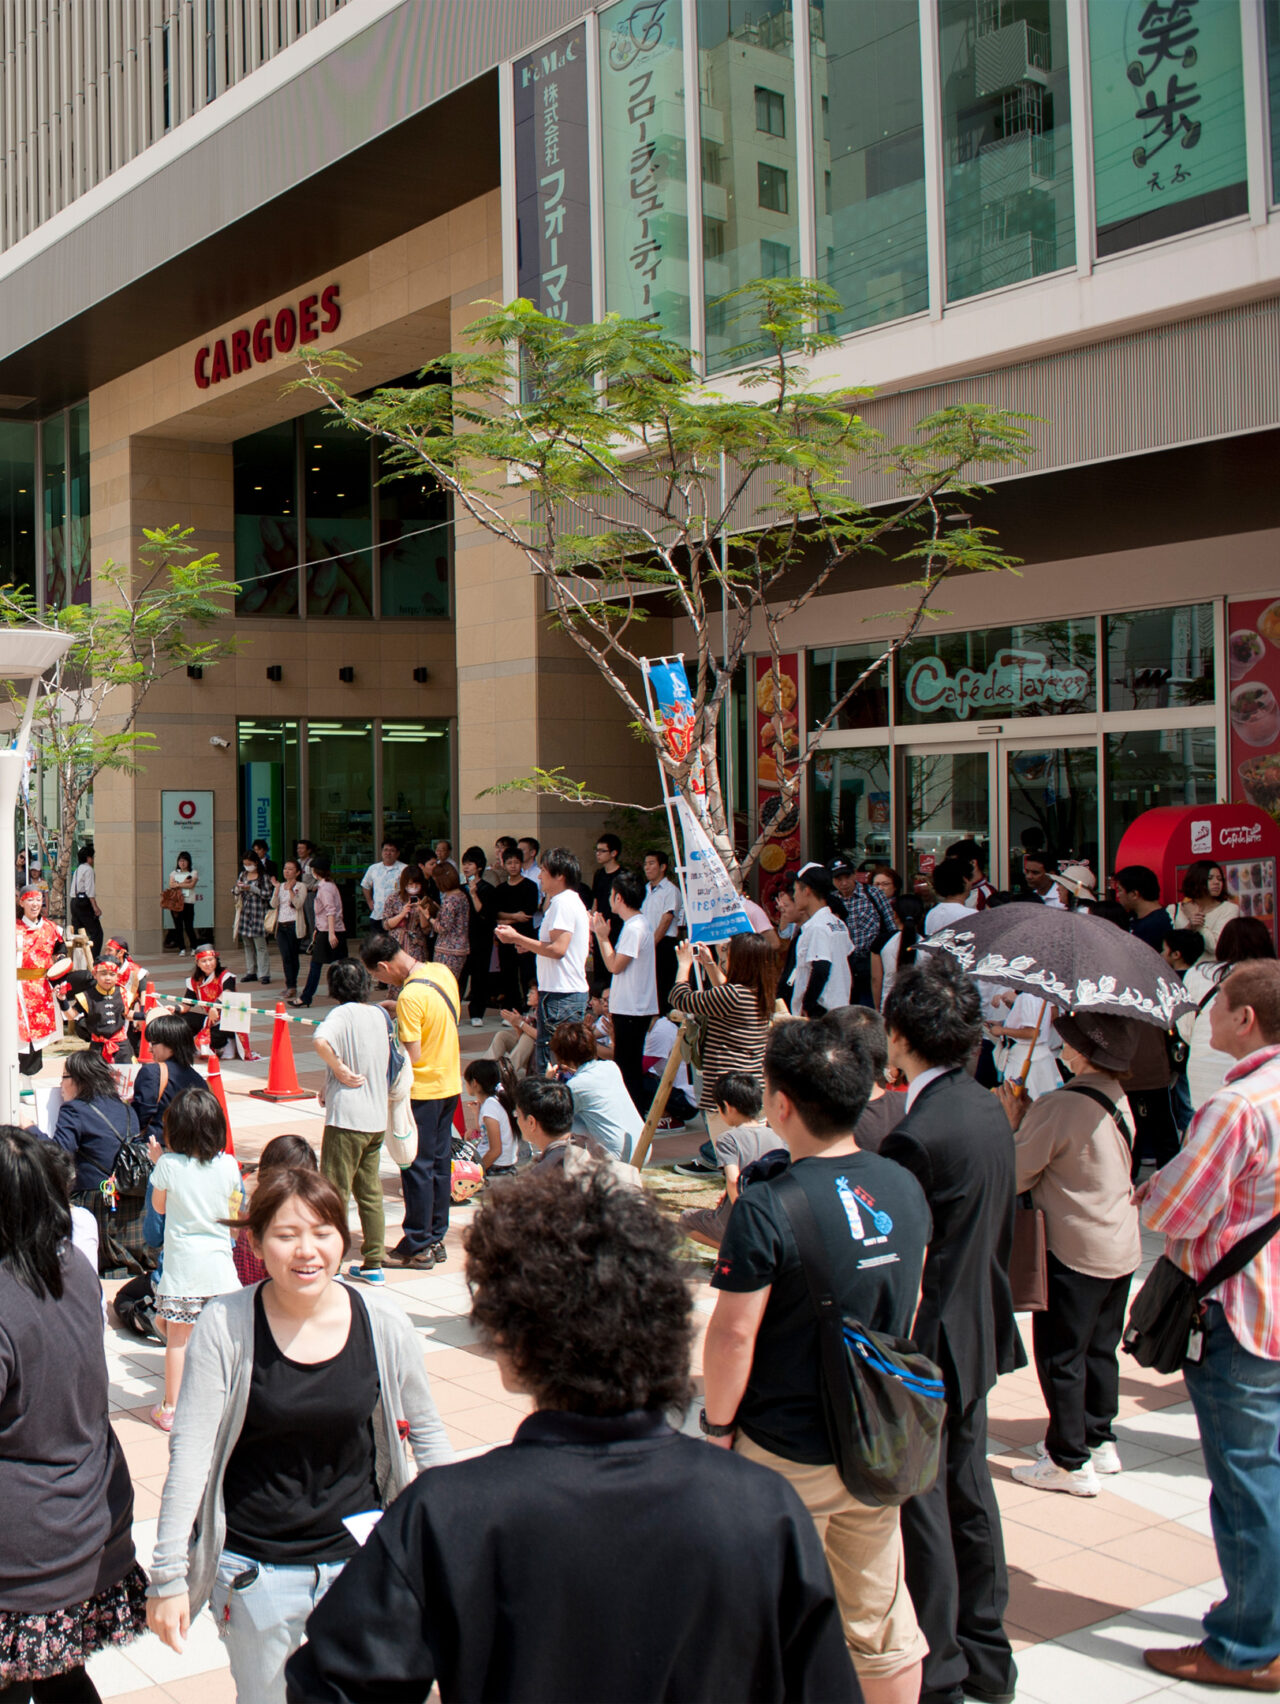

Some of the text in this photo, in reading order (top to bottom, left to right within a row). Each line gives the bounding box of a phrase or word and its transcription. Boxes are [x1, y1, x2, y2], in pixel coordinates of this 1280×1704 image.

[540, 82, 568, 323] 株式会社 フォーマッ
[194, 285, 341, 389] CARGOES
[910, 664, 980, 714] Café
[984, 669, 1014, 700] des
